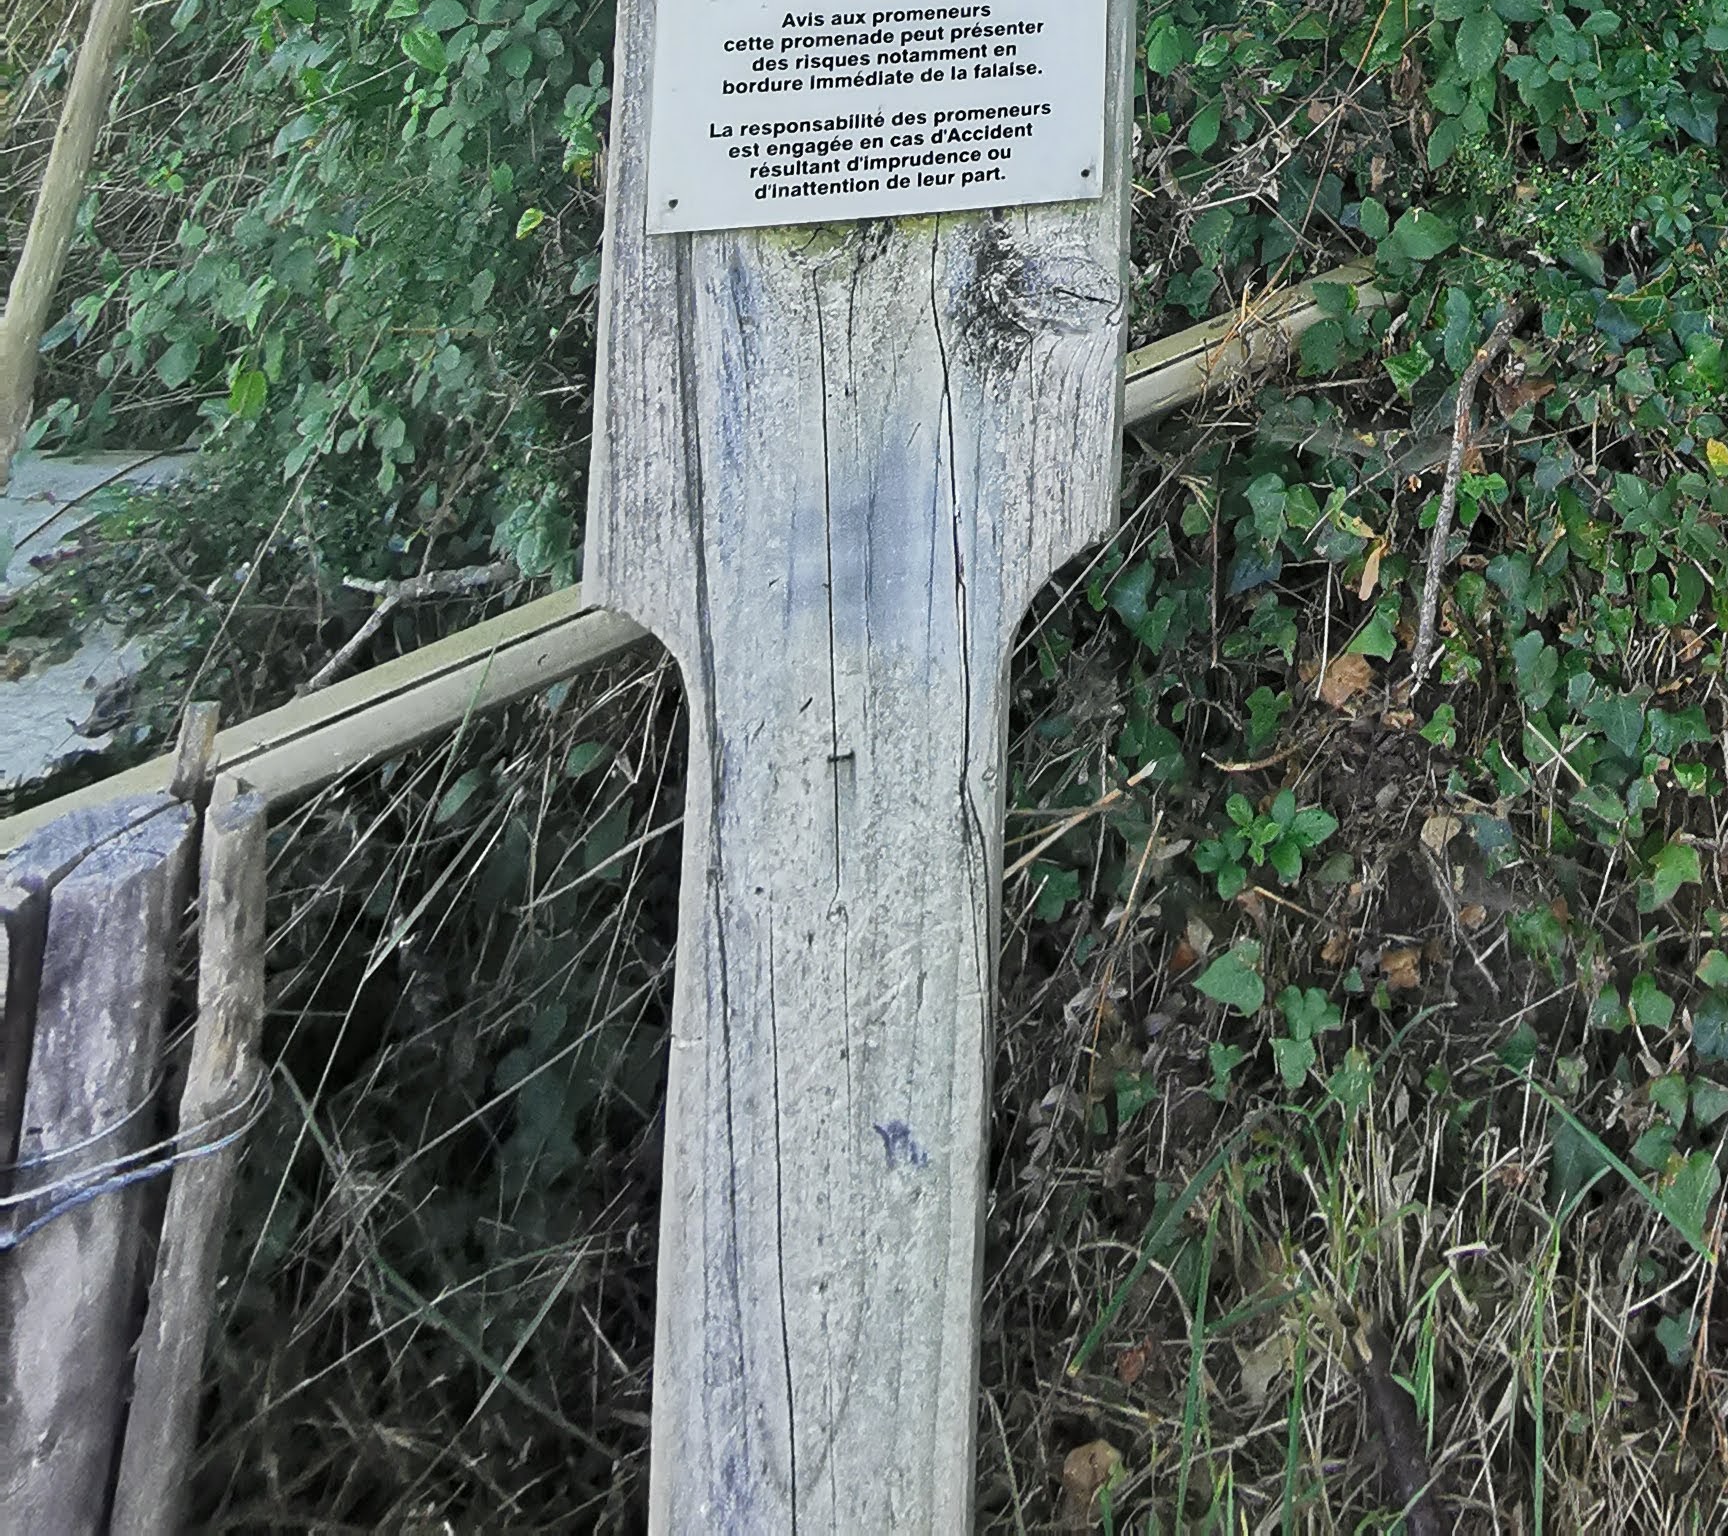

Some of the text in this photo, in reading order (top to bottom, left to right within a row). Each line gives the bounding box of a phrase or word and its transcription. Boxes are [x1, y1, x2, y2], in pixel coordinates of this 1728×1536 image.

[781, 5, 991, 29] Avis aux promeneurs
[723, 20, 1045, 54] cette promenade peut présenter
[751, 43, 1017, 72] des risques notamment en
[722, 61, 1043, 95] bordure immédiate de la falaise.
[709, 103, 1052, 139] La responsabilité des promeneurs
[728, 122, 1033, 159] est engagée en cas d'Accident
[749, 147, 1012, 179] résultant d'imprudence ou
[754, 166, 1006, 200] d'inattention de leur part.
